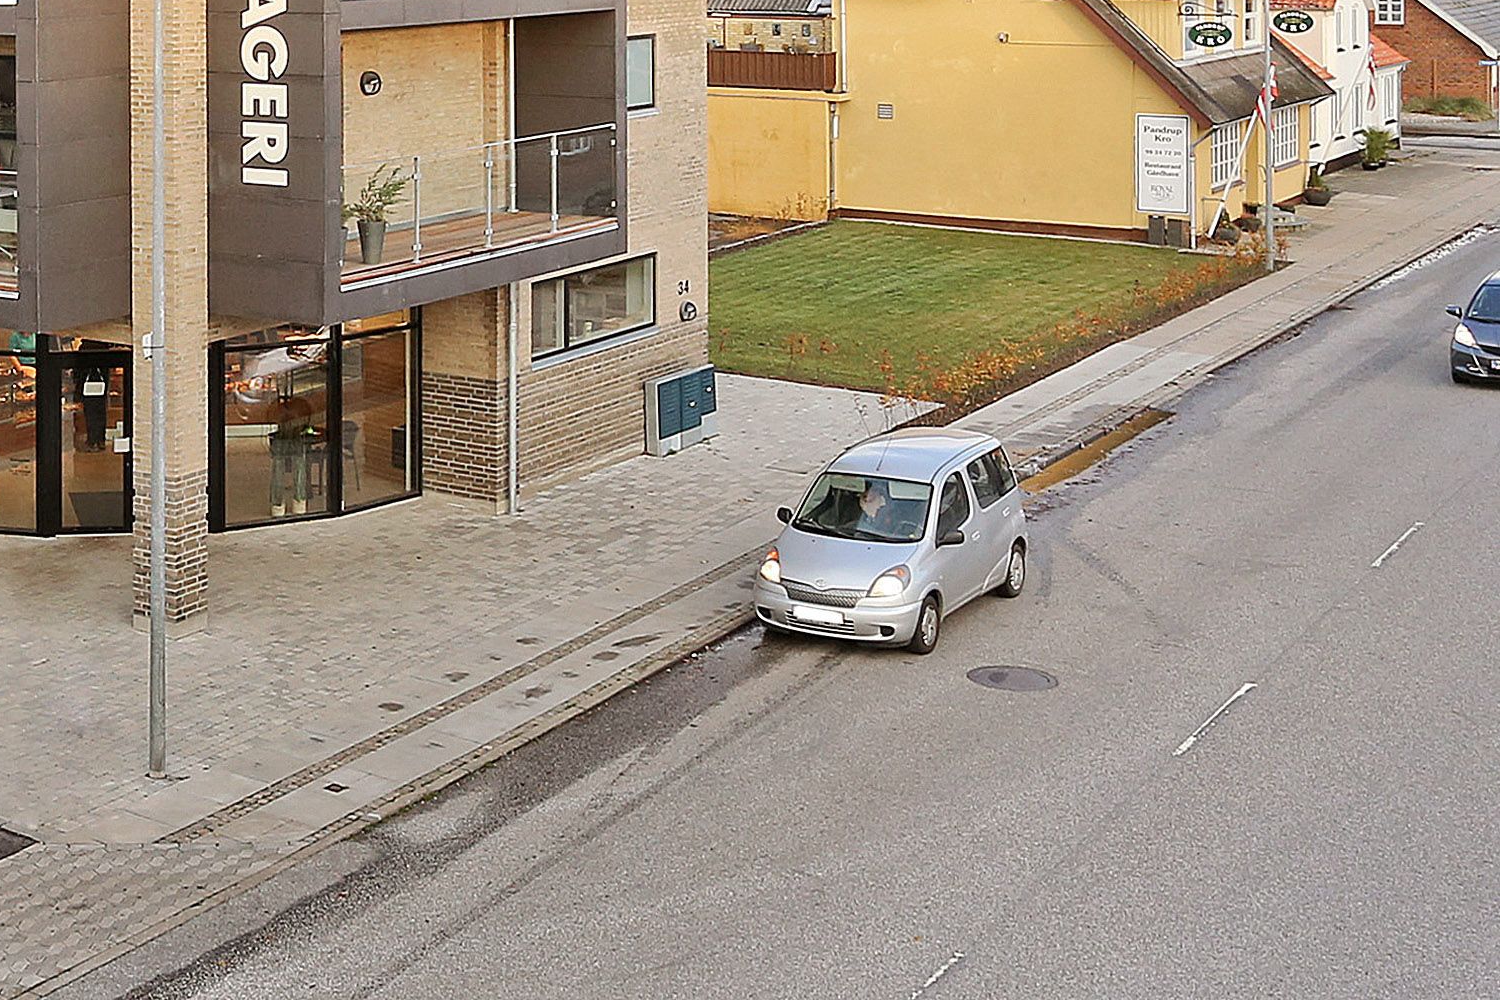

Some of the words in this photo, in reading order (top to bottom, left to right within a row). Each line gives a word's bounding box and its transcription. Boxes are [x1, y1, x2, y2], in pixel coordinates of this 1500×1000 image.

[1280, 22, 1308, 32] KRO
[1195, 35, 1226, 46] KRO
[1143, 125, 1183, 136] Pandrup
[1154, 134, 1172, 142] Kro
[677, 279, 690, 296] 34
